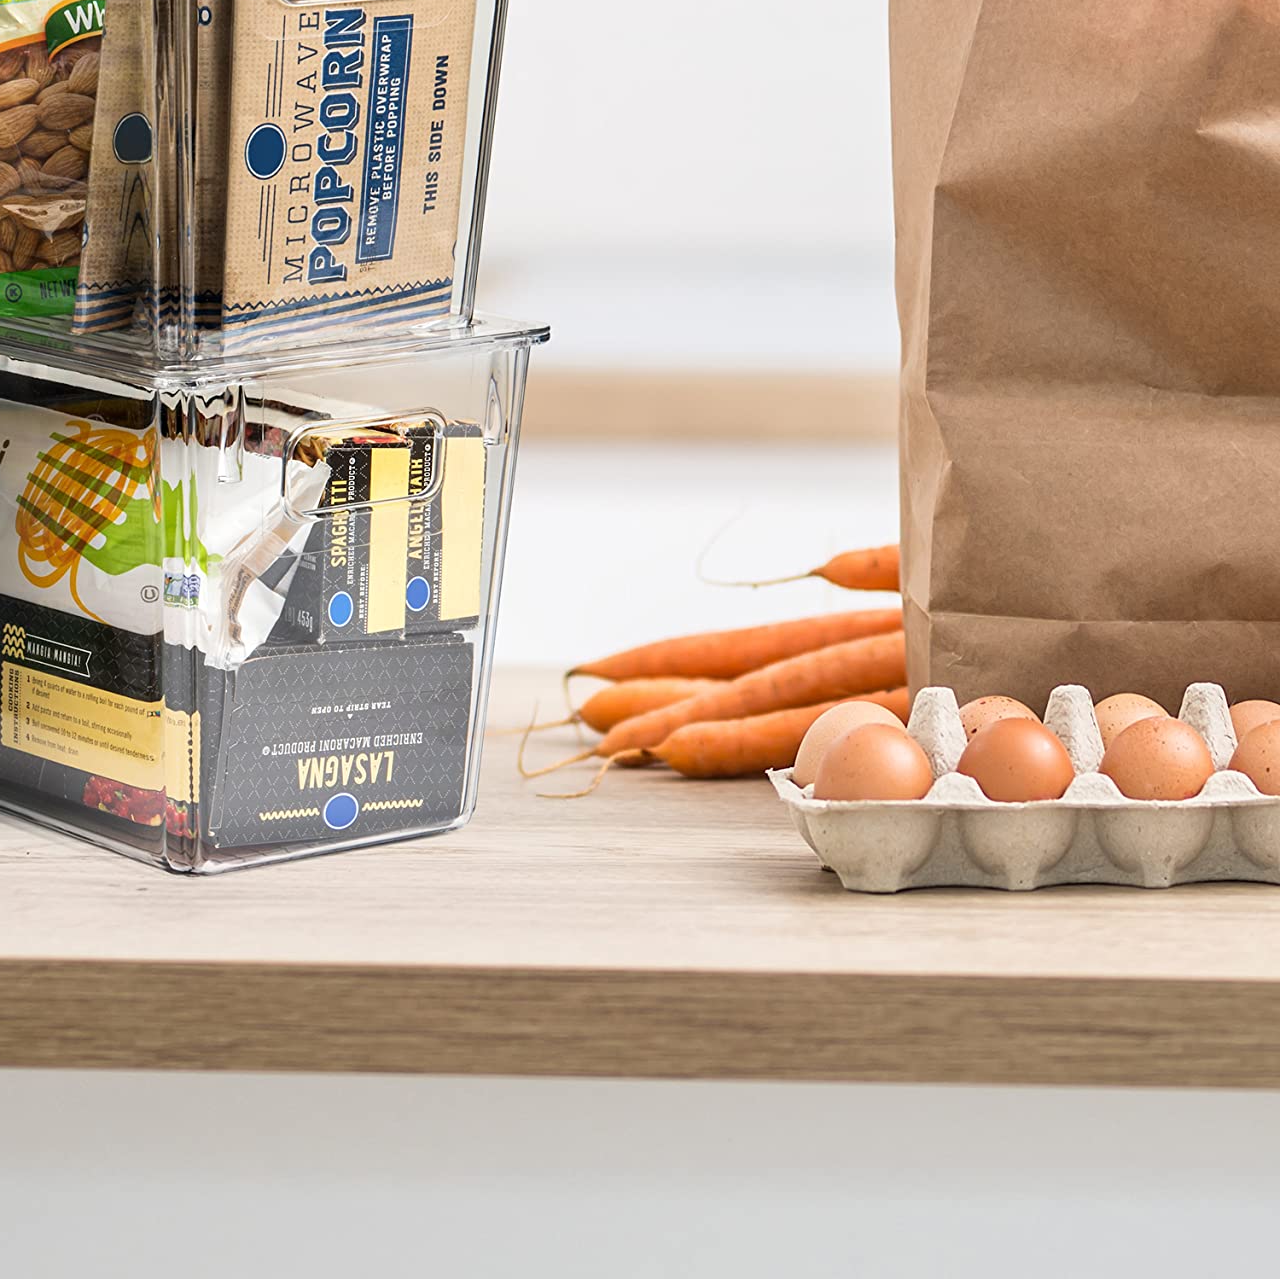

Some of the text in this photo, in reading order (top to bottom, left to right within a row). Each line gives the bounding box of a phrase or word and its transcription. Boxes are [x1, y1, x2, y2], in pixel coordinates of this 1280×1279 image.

[376, 34, 392, 114] OVERWRAP
[283, 11, 320, 285] MICROWAVE
[306, 7, 368, 287] POPCORN
[371, 120, 385, 180] PLASTIC
[382, 77, 401, 200] BEFORE POPPING
[422, 55, 450, 215] THIS SIDE DOWN
[365, 186, 381, 245] REMOVE
[347, 465, 356, 584] ENRICHED PRODUCT
[408, 505, 424, 560] ANGEL
[26, 641, 51, 659] MANGIA
[311, 701, 391, 715] TEAR STRIP TO OPEN
[271, 732, 424, 756] ENRICHED MACARONI PRODUCT
[297, 750, 395, 790] LASAGNA
